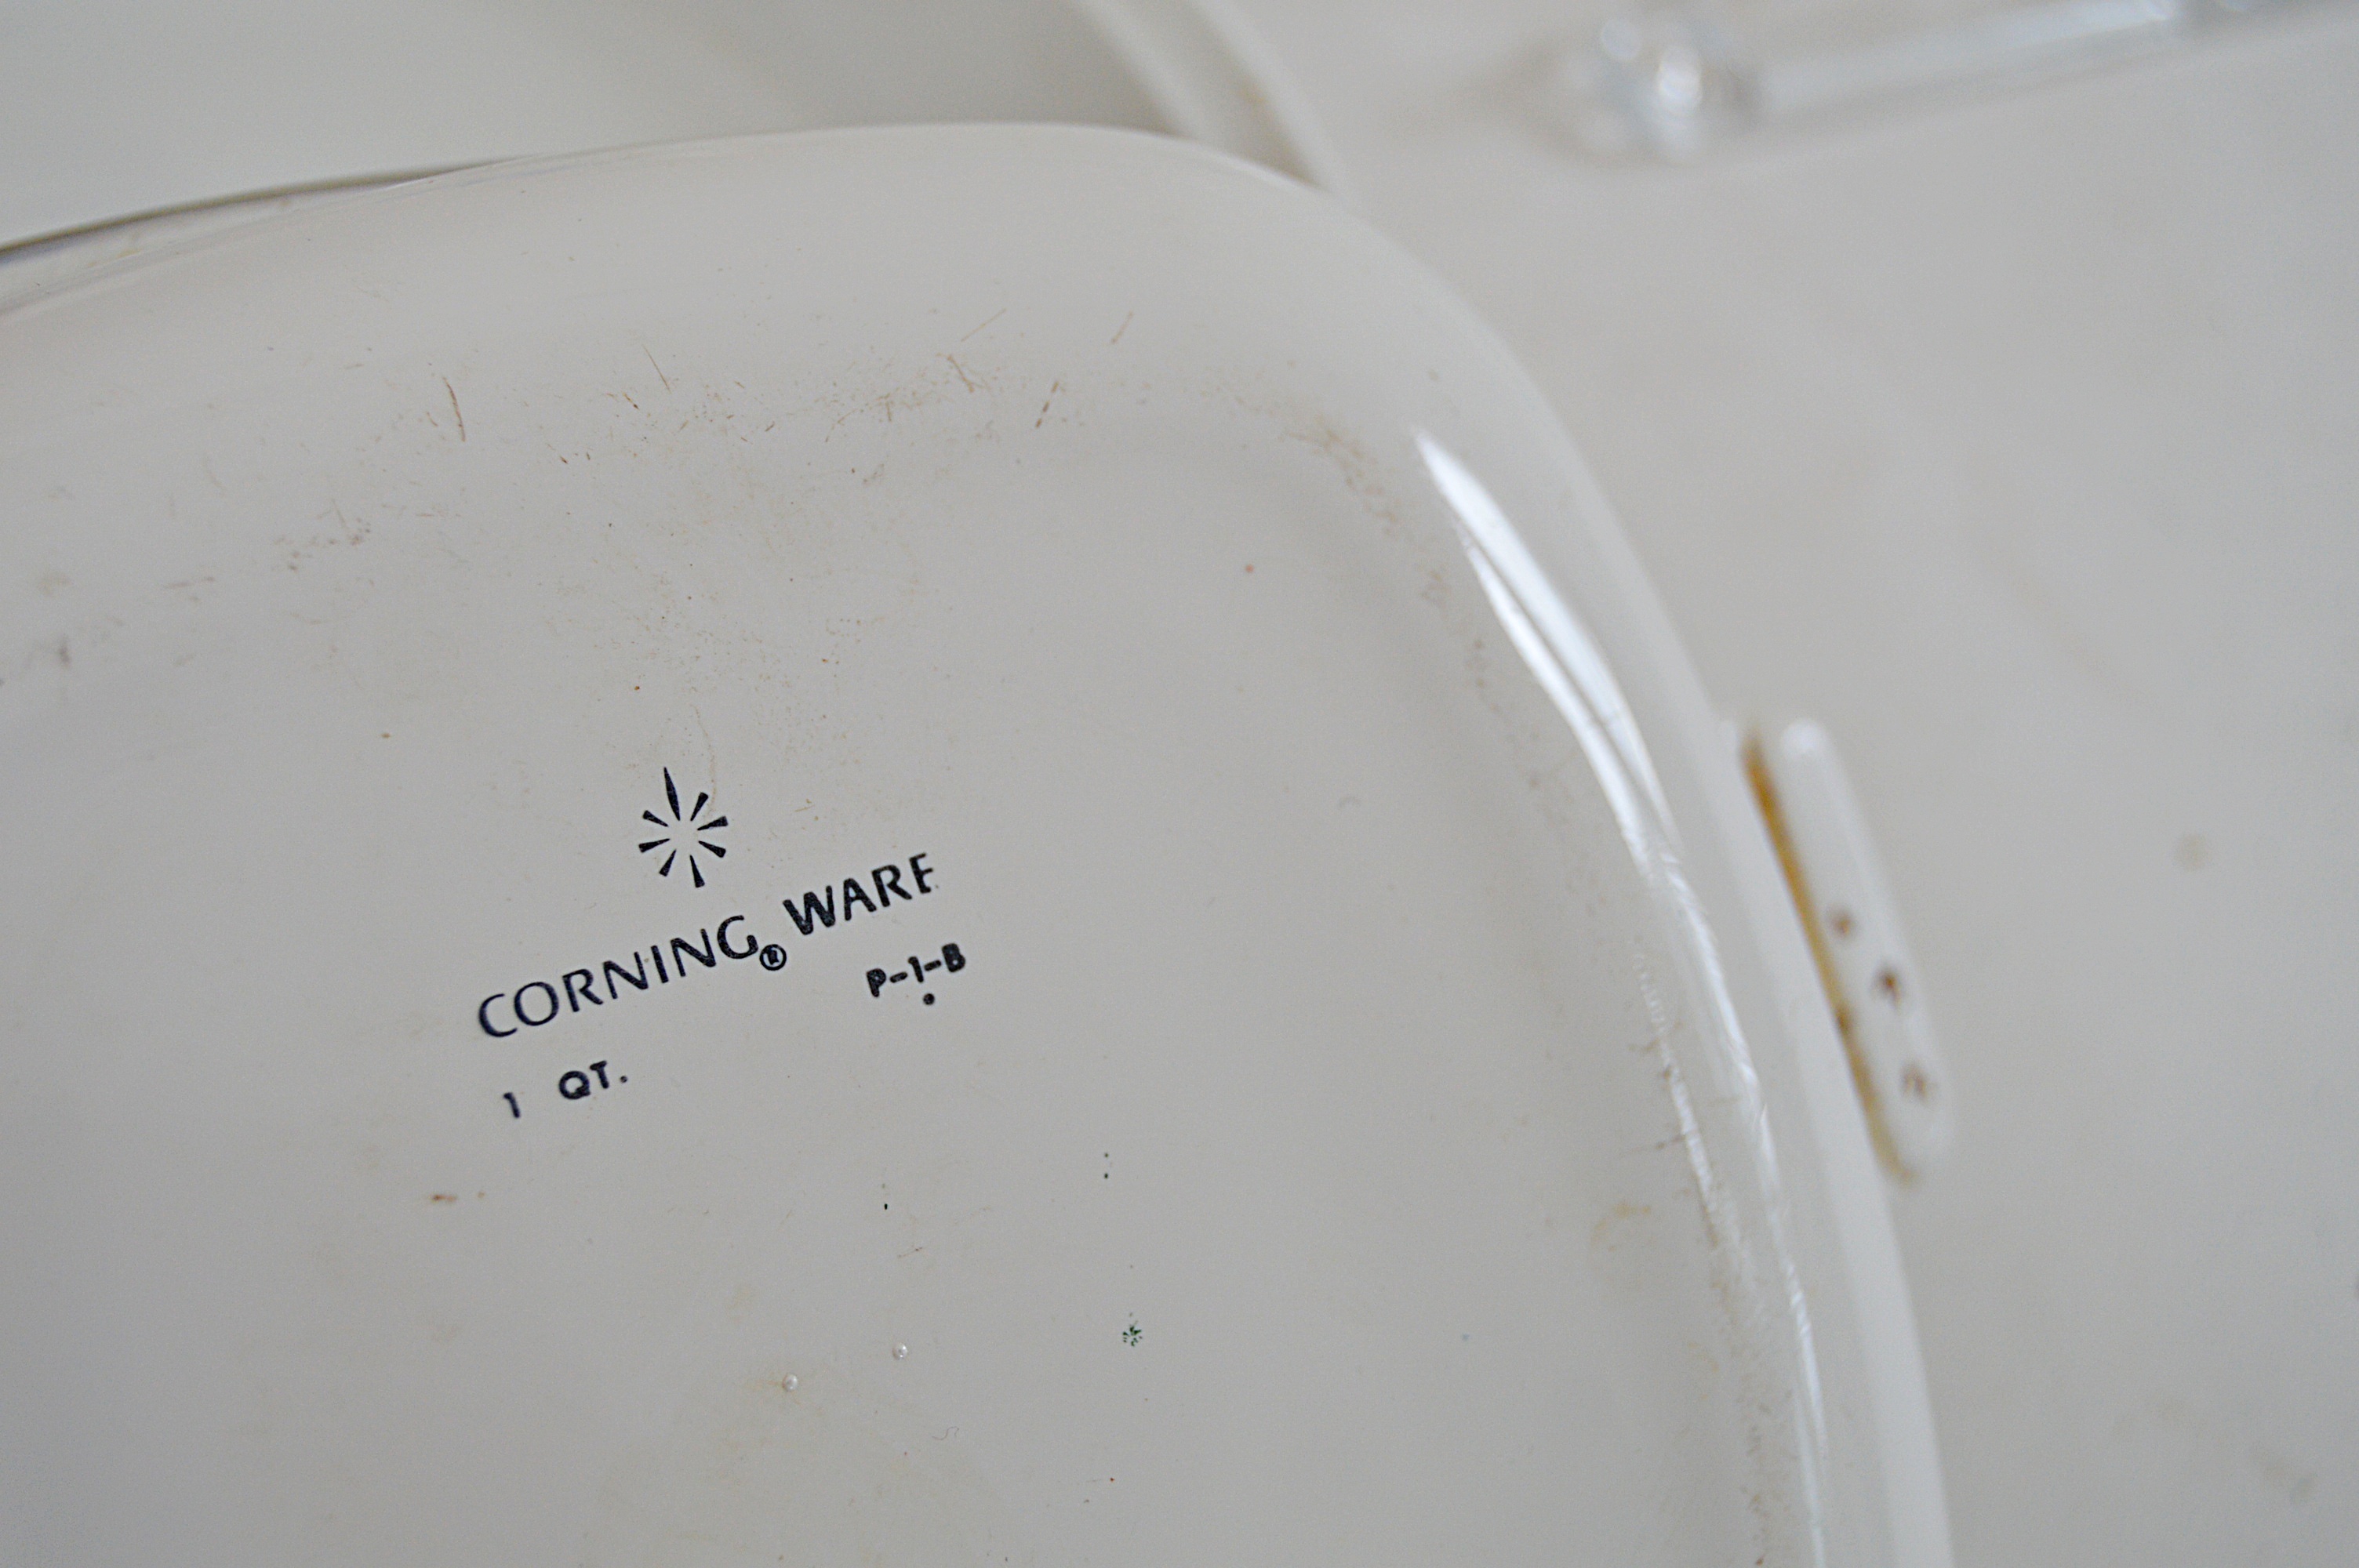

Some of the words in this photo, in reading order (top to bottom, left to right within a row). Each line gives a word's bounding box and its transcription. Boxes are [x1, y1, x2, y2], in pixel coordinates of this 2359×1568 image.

[782, 852, 935, 936] WARE
[866, 942, 966, 998] P-1-B
[503, 1091, 521, 1119] 1
[558, 1060, 628, 1101] QT.
